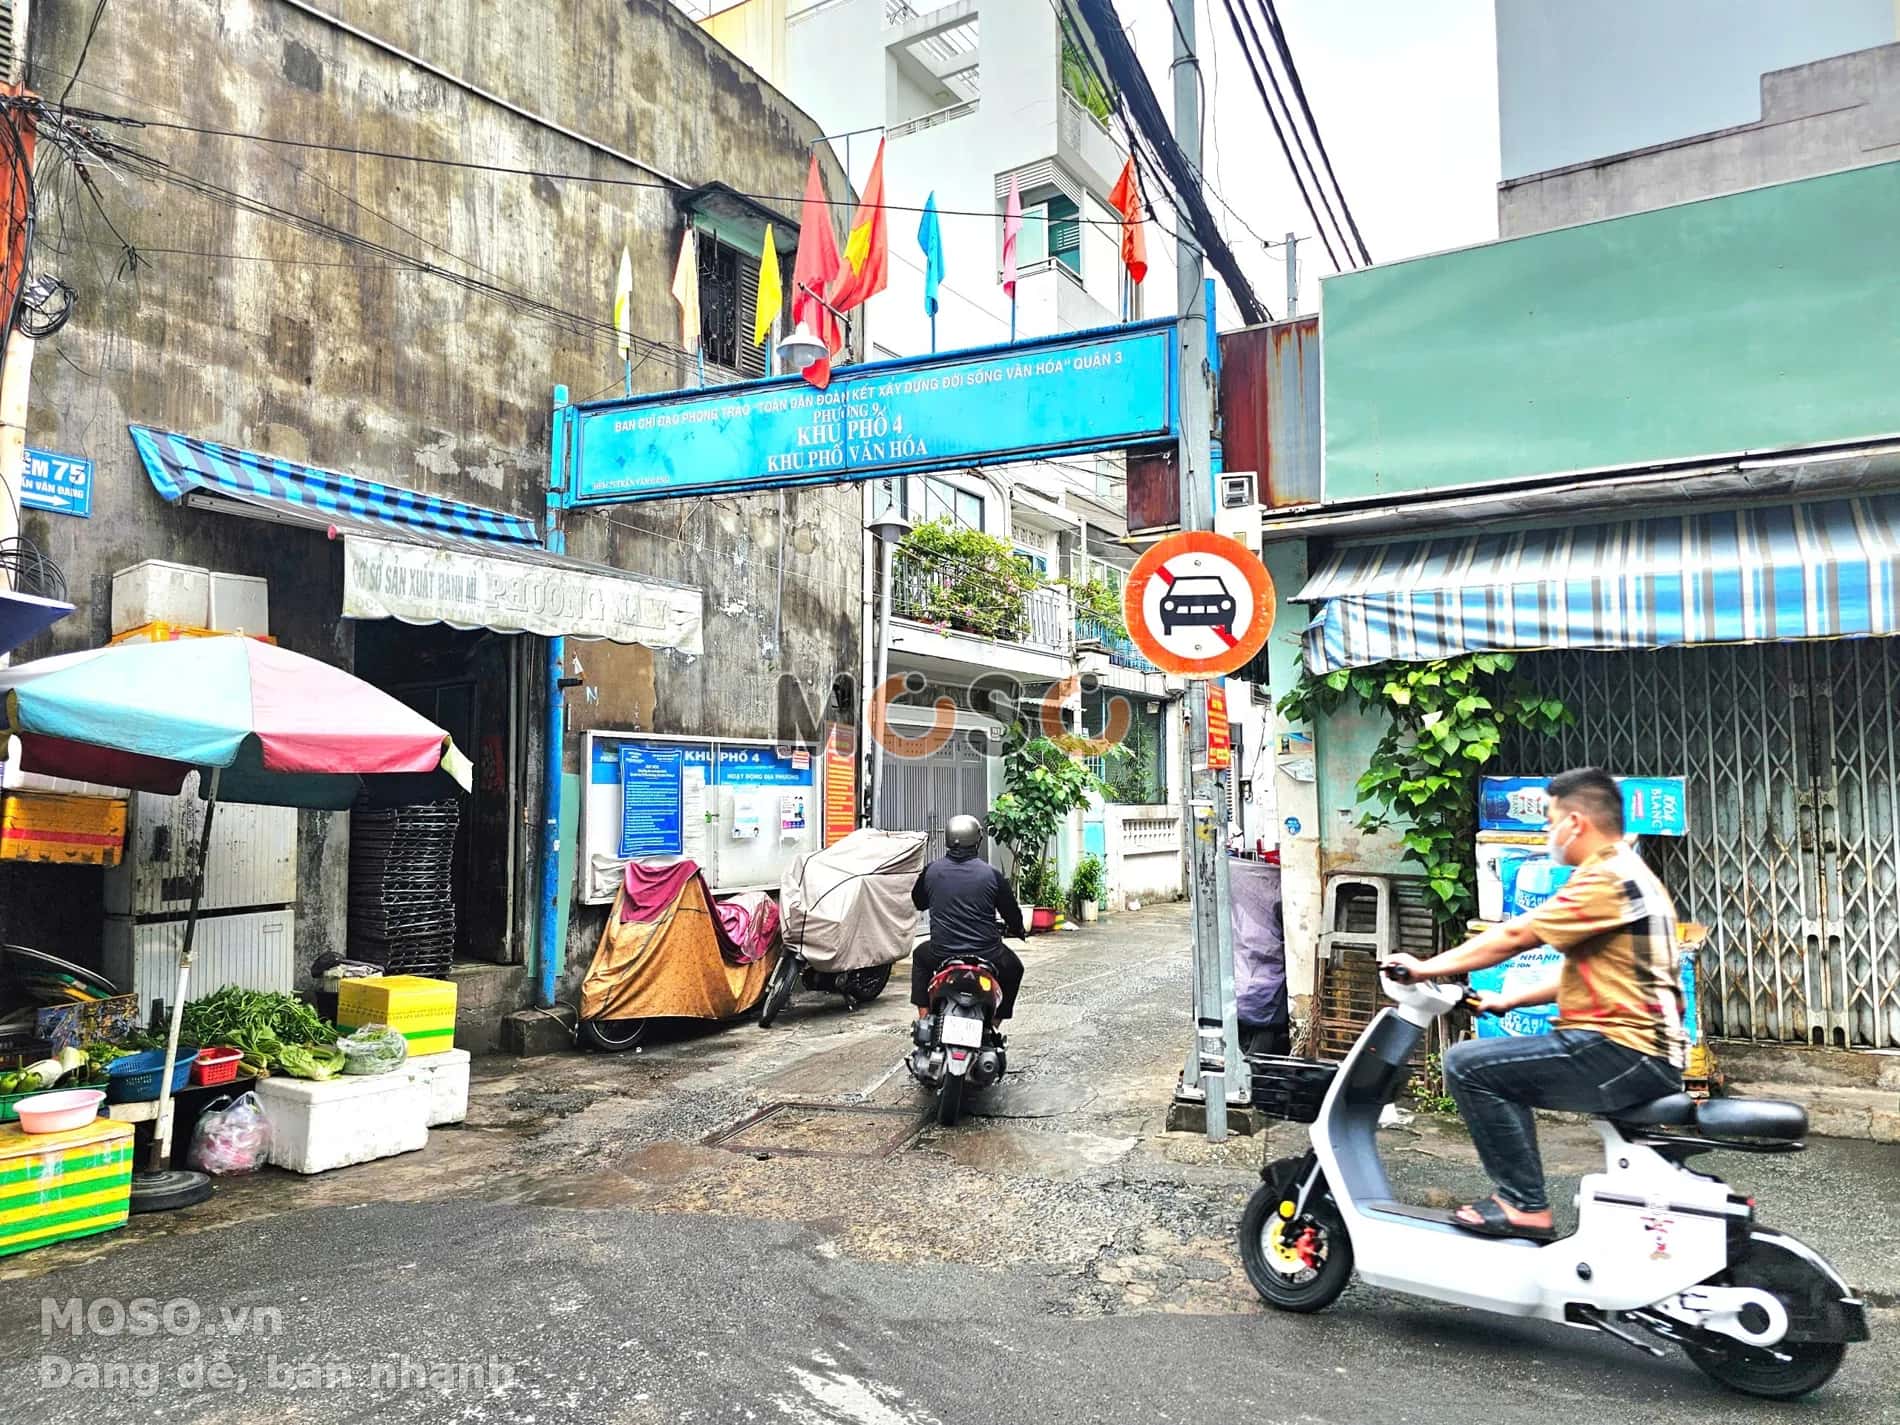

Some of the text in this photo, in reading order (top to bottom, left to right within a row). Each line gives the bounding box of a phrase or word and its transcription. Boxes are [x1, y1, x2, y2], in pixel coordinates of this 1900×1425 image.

[615, 420, 635, 432] BAN
[967, 366, 1002, 385] SỐNG
[1115, 351, 1123, 364] 3
[797, 407, 903, 446] KHU PHỐ 4
[51, 459, 87, 485] 75
[767, 432, 928, 473] KHU PHỐ VĂN HÓA
[684, 748, 760, 763] KHU PHỐ 4
[1651, 788, 1663, 829] BLANC
